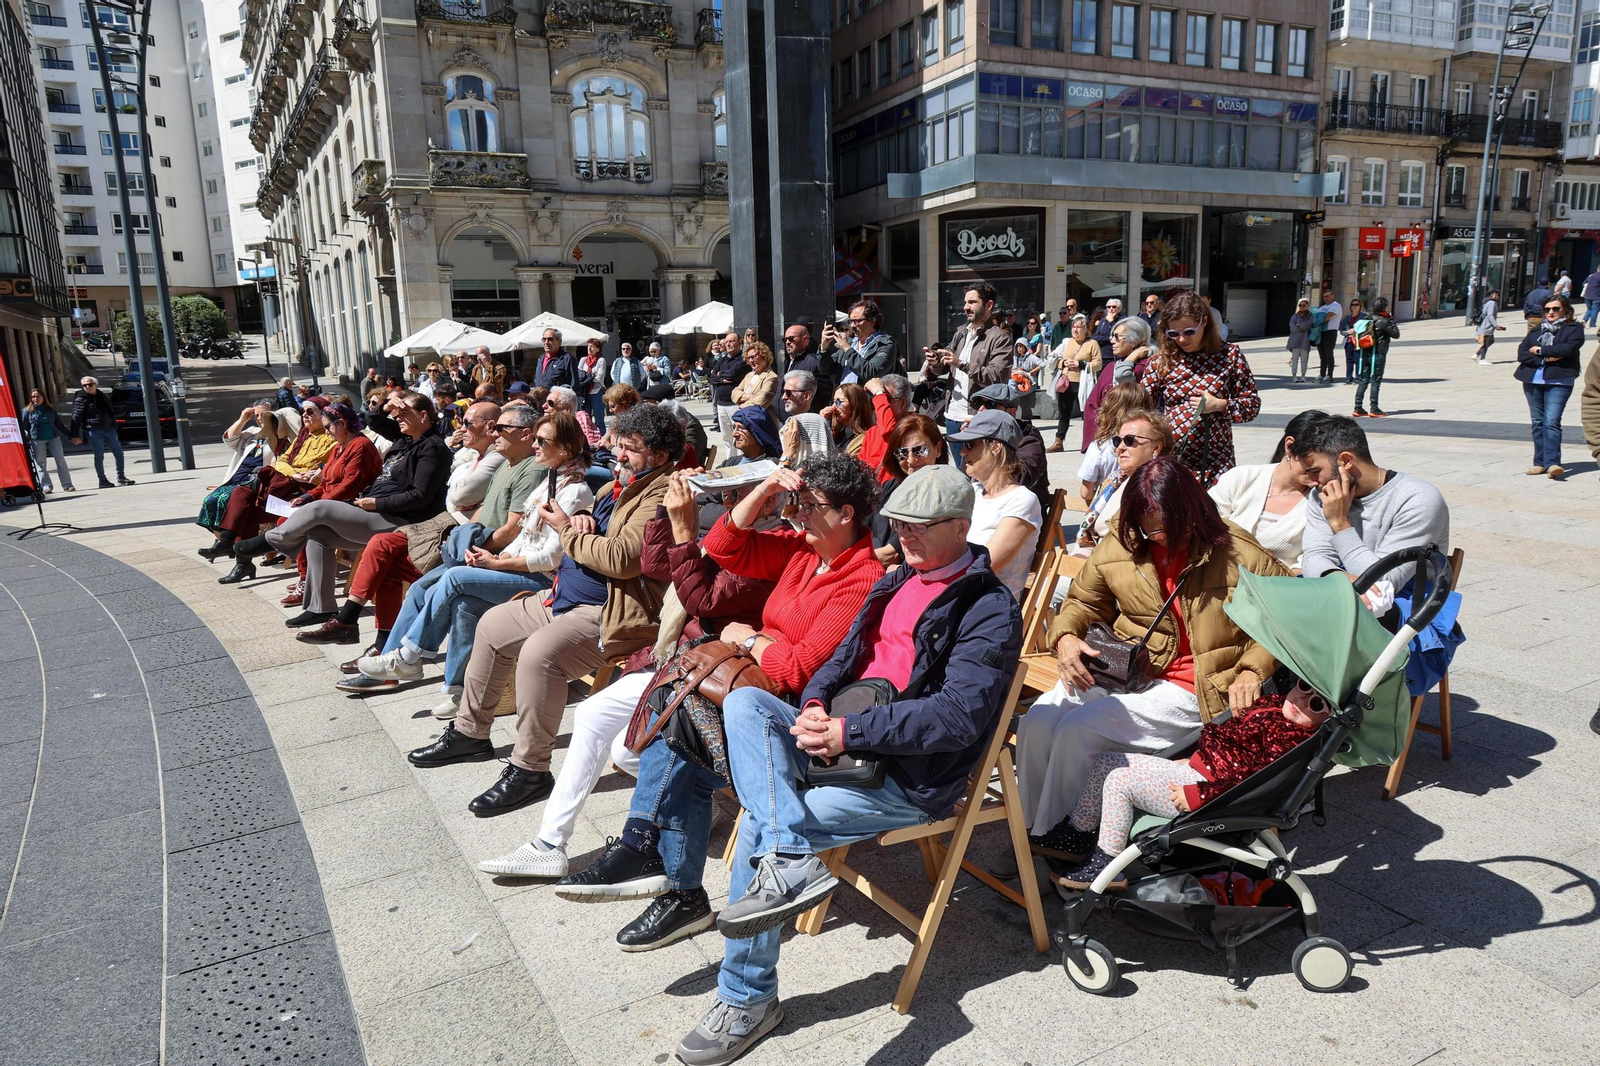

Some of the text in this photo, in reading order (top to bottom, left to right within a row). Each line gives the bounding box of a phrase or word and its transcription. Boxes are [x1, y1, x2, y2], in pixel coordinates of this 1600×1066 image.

[1068, 86, 1103, 98] OCASO
[1217, 100, 1248, 112] OCASO
[615, 214, 620, 222] 6
[1453, 228, 1463, 238] AS
[1200, 823, 1225, 833] YOYO
